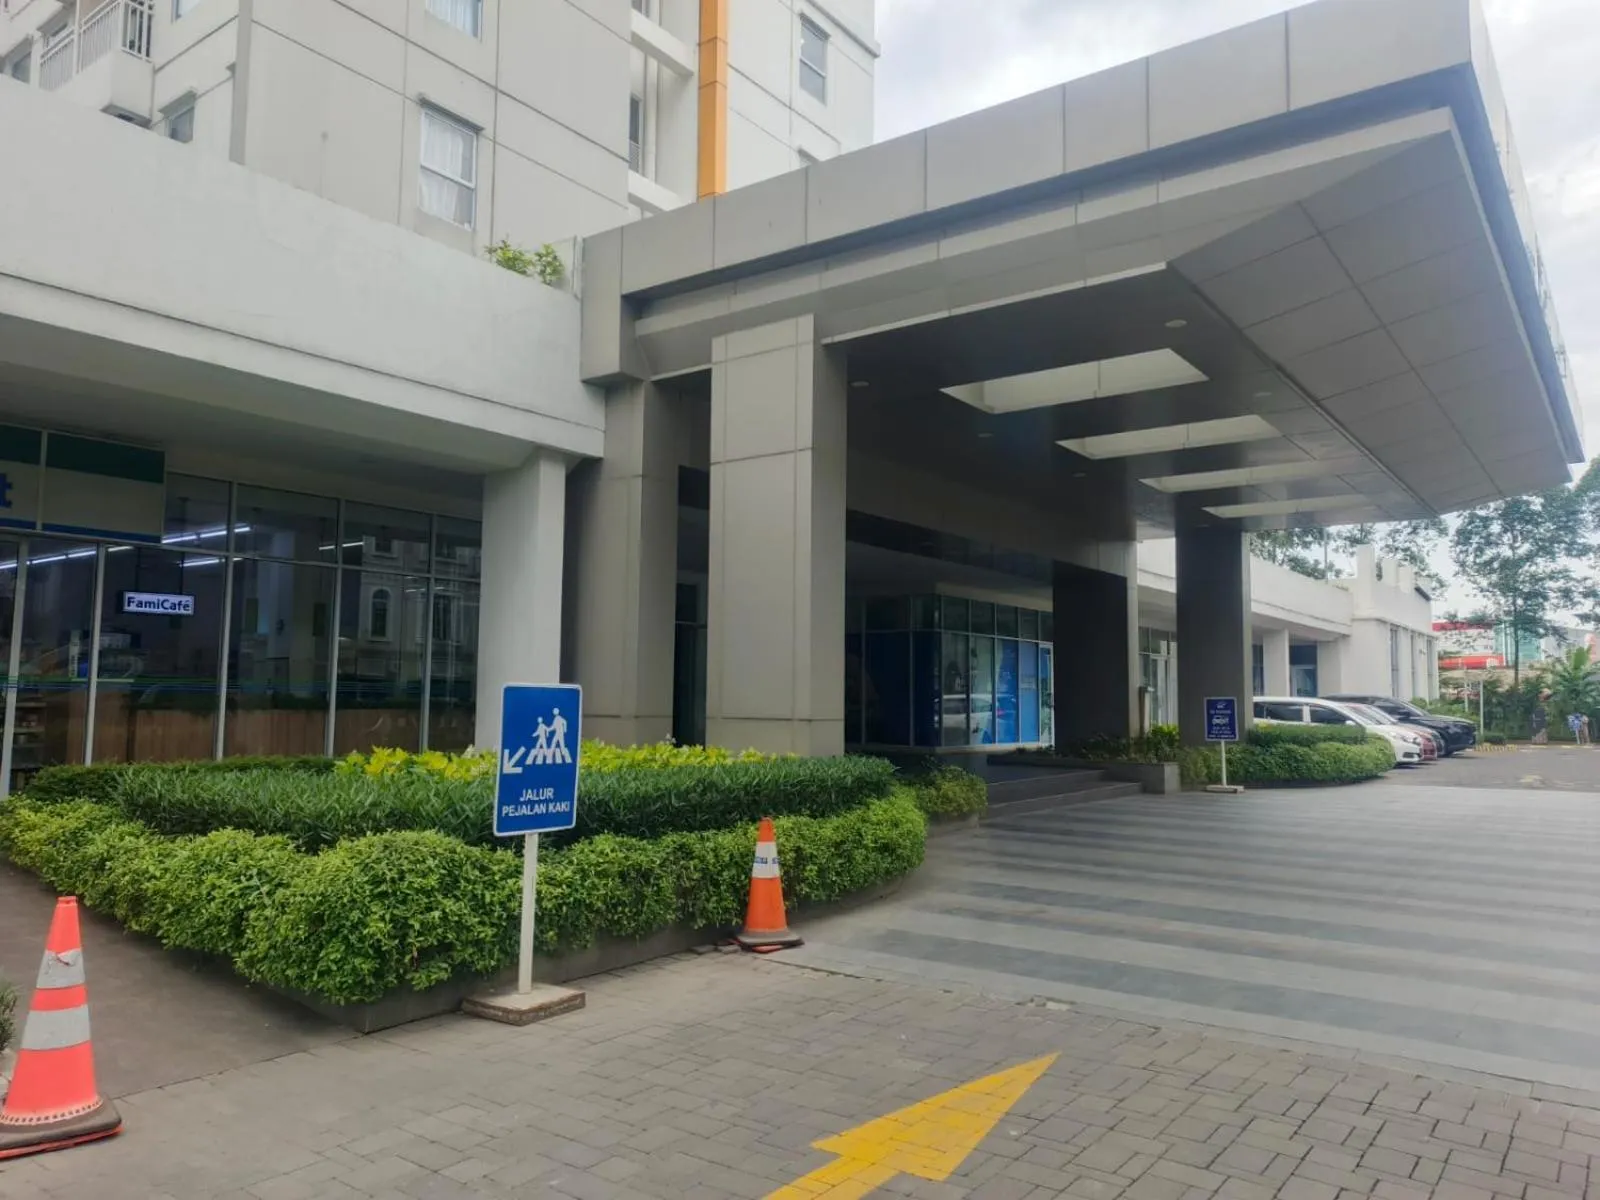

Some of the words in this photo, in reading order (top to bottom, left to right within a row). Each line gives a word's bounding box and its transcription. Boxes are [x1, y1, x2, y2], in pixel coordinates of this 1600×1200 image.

[126, 596, 191, 612] FamiCafé
[519, 787, 554, 802] JALUR
[502, 803, 546, 817] PEJALAN
[548, 801, 570, 813] KAKI
